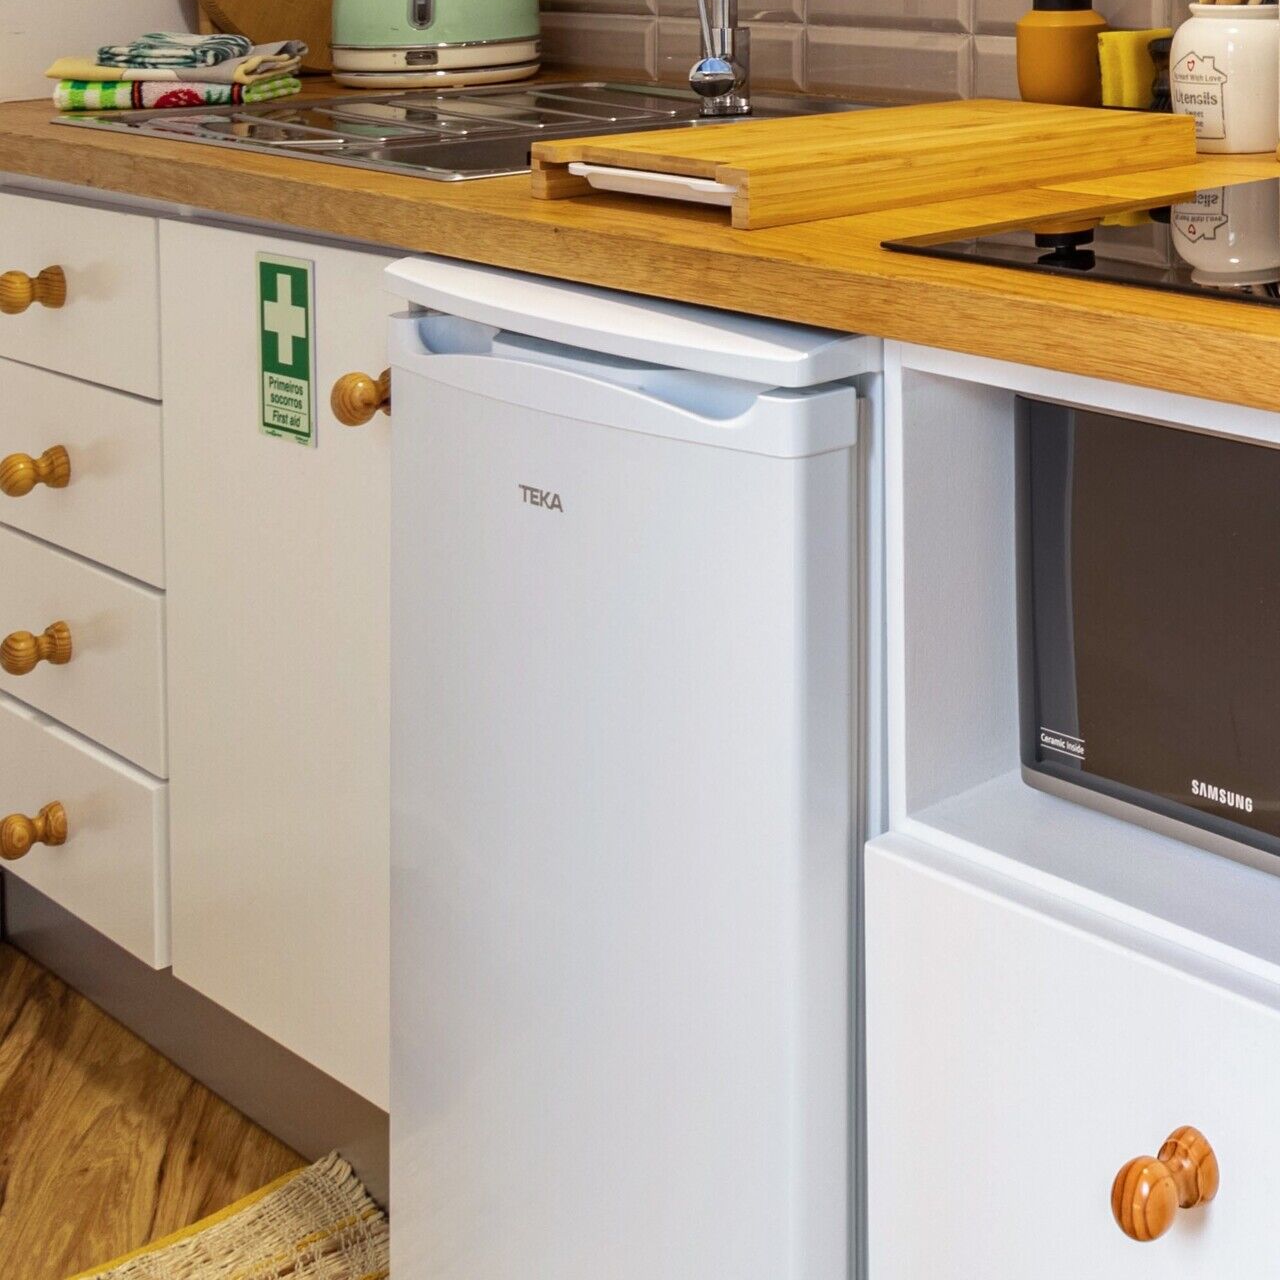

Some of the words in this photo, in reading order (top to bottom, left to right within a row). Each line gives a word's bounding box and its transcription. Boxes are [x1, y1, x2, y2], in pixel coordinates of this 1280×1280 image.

[1175, 88, 1218, 106] Utensils
[269, 375, 303, 396] Primeiros
[270, 393, 302, 410] socorros
[273, 410, 288, 424] First
[289, 413, 301, 427] aid
[518, 483, 563, 513] TEKA
[1040, 732, 1066, 749] Ceramic
[1066, 738, 1085, 755] Inside
[1191, 778, 1254, 813] SAMSUNG
